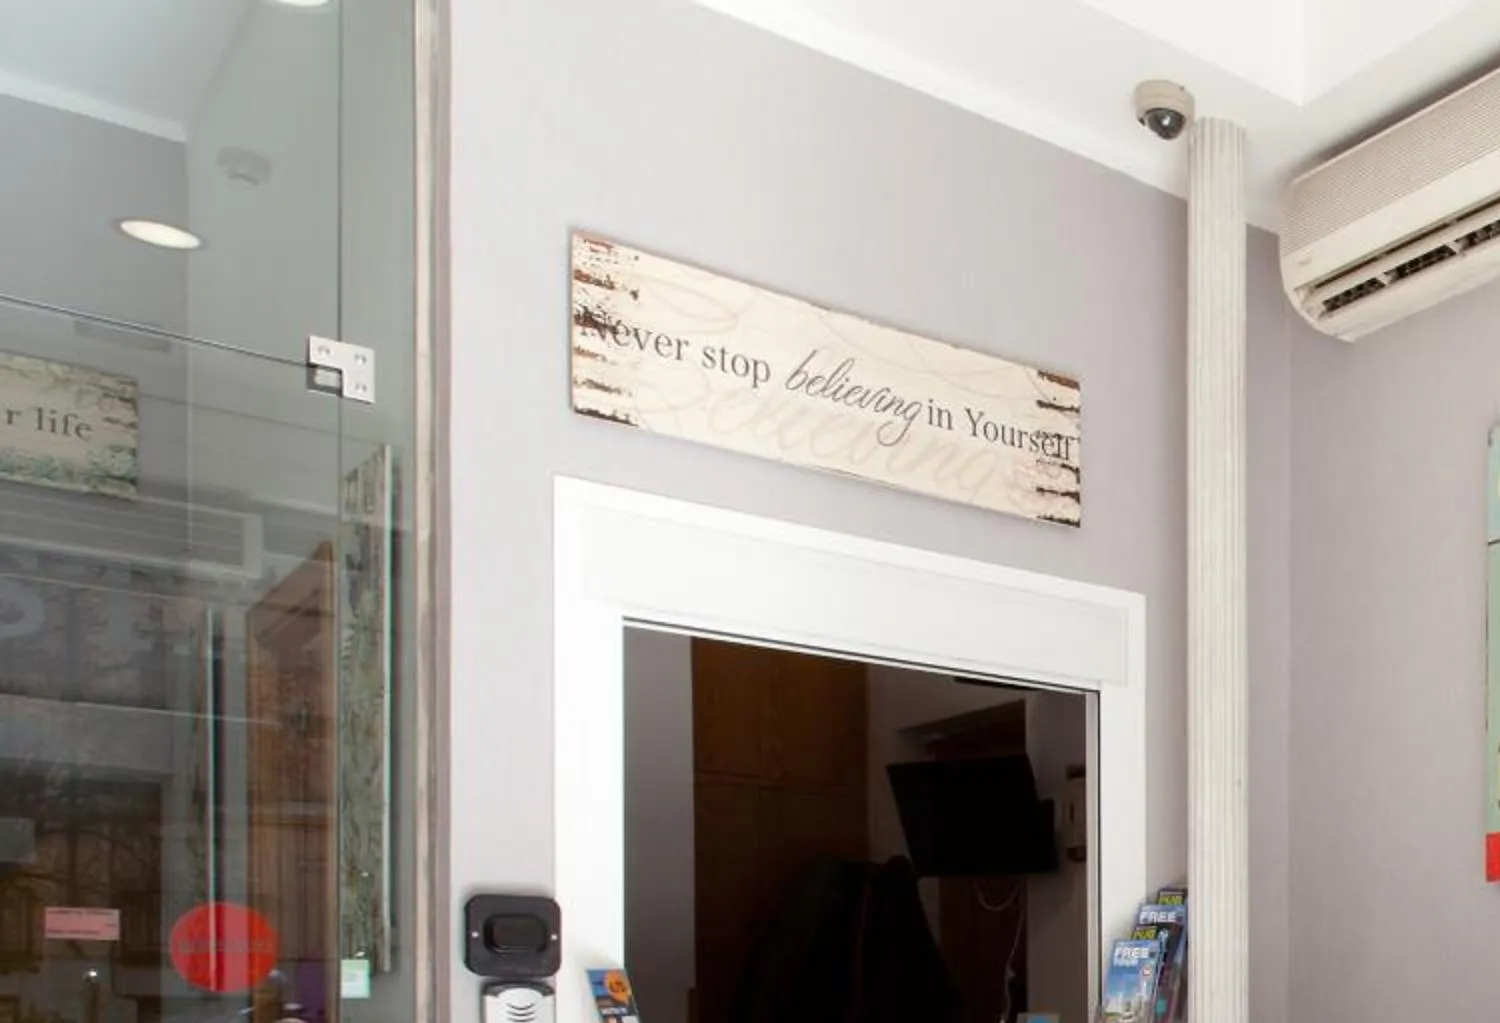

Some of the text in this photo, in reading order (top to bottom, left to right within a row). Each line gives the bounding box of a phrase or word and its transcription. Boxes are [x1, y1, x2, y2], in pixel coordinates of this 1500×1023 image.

[578, 305, 1074, 461] Never stop believing in Yourself
[36, 406, 94, 442] life
[1139, 911, 1178, 925] FREE
[1113, 946, 1150, 960] FREE
